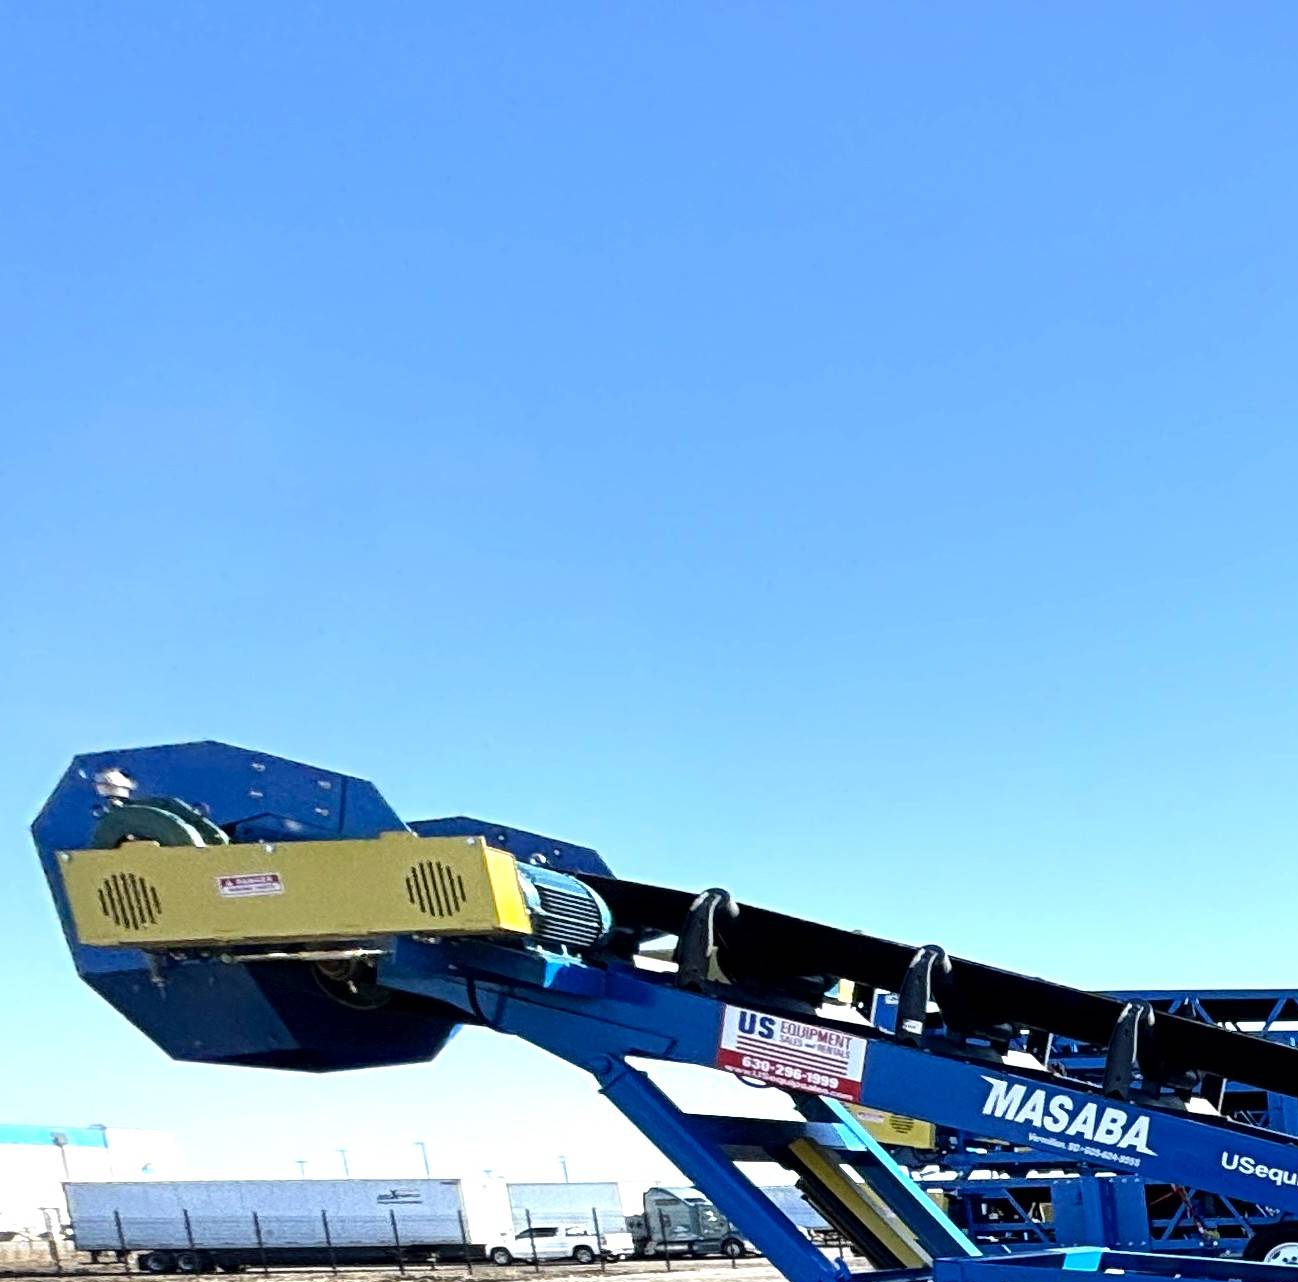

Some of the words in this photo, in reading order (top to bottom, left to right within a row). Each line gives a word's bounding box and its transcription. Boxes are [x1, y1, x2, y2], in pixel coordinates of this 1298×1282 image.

[738, 1011, 776, 1039] US
[780, 1021, 853, 1048] EQUIPMENT
[742, 1056, 839, 1088] 630-296-1999
[980, 1075, 1158, 1156] MASABA
